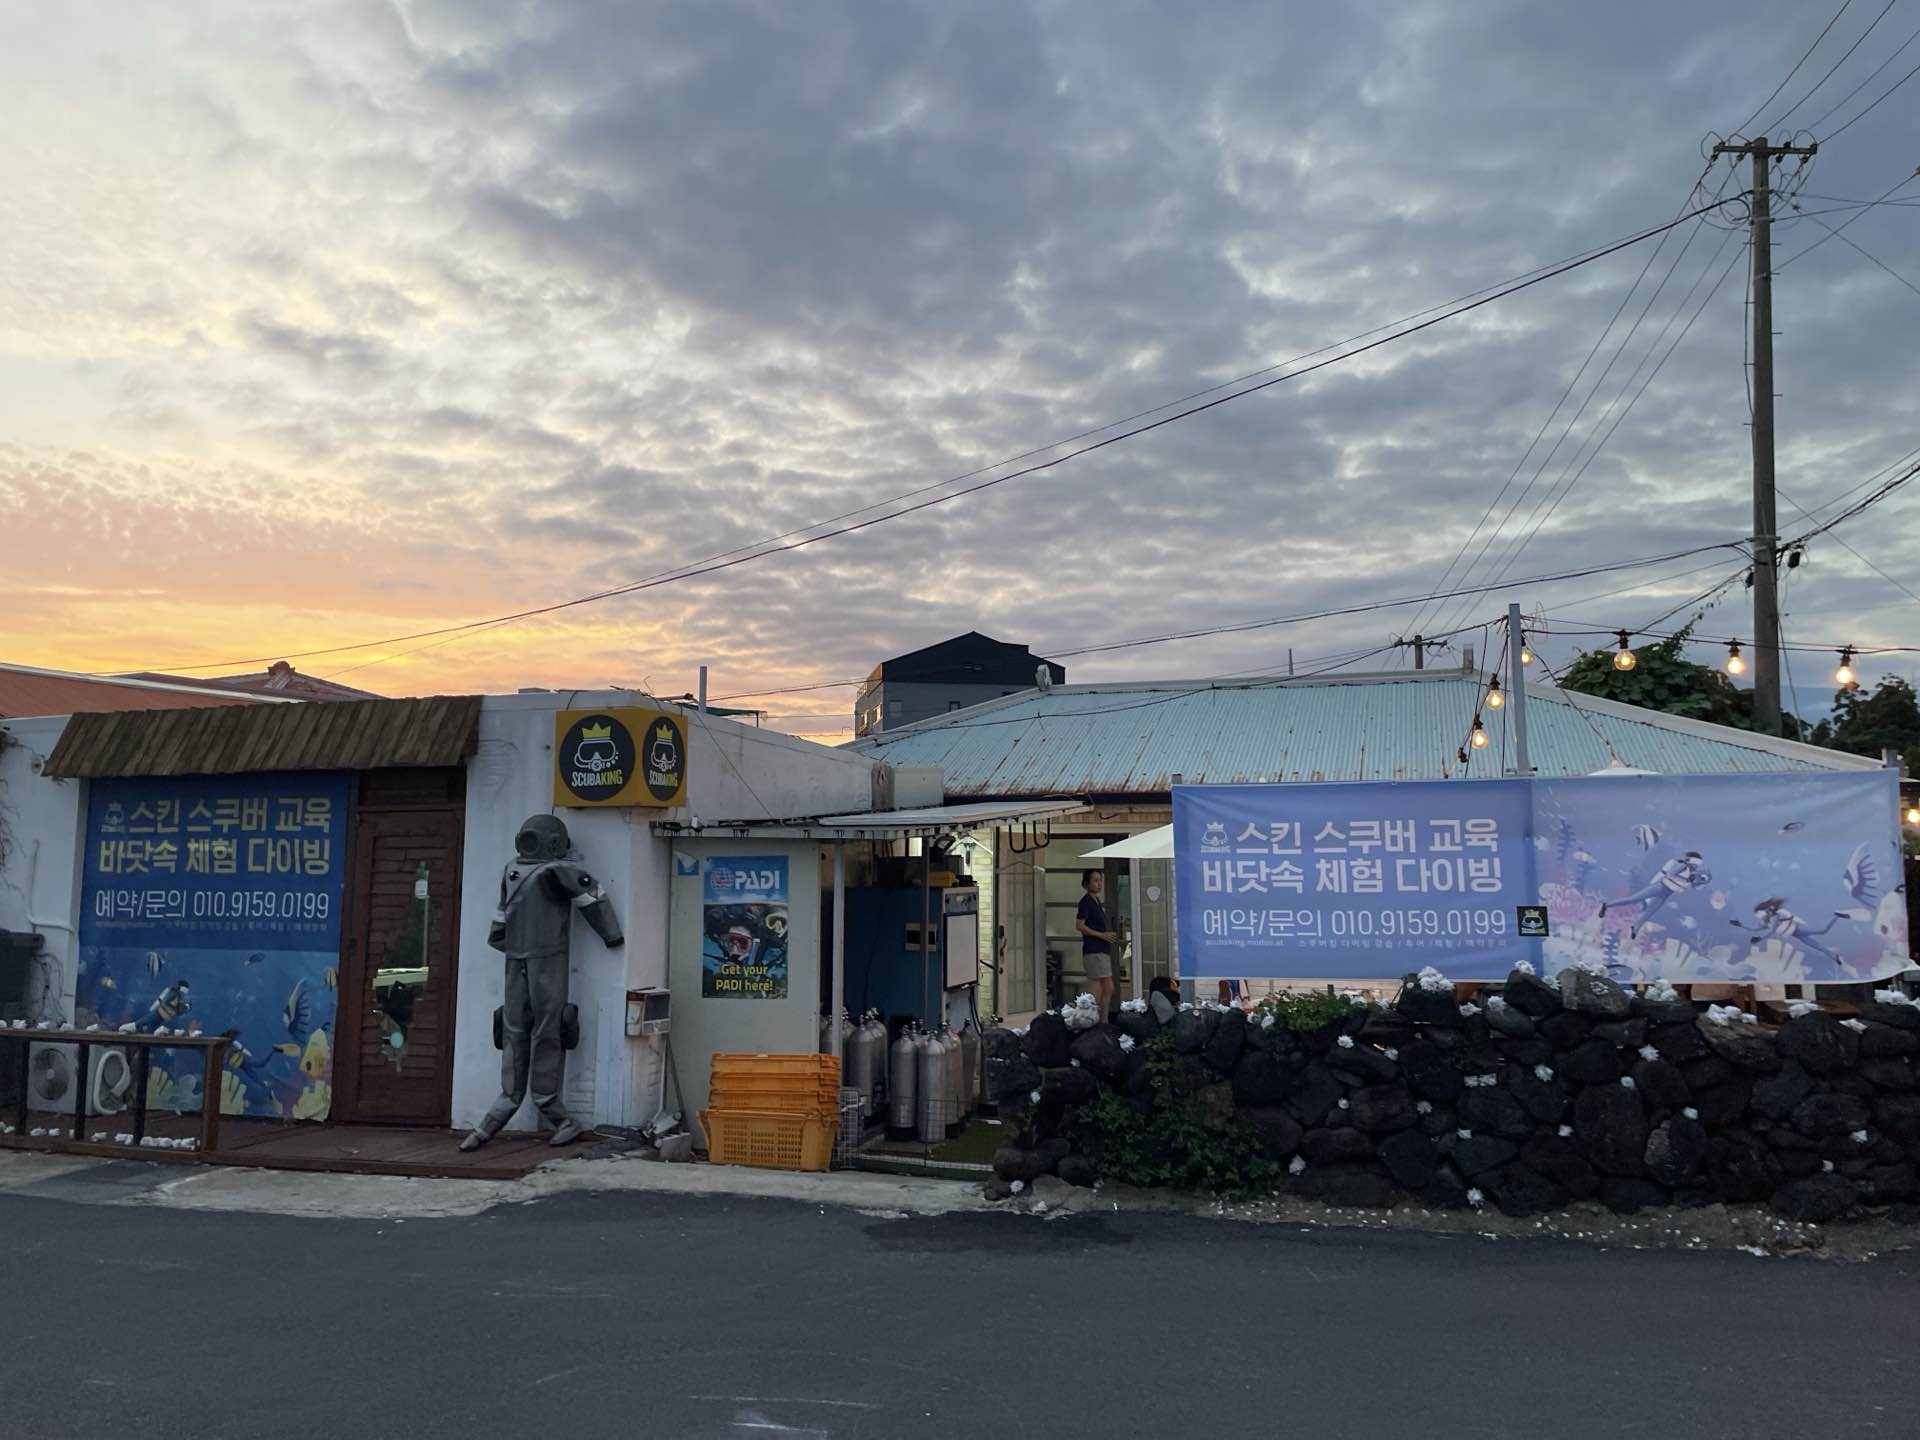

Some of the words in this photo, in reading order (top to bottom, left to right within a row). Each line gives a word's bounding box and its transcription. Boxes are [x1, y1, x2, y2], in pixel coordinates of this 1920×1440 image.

[571, 769, 623, 787] SCUBAKING
[649, 770, 678, 787] SCUBAKING
[129, 800, 180, 833] 스킨
[187, 798, 267, 833] 스쿠버
[275, 798, 332, 833] 교육
[1236, 822, 1302, 854] 스킨
[1314, 819, 1416, 854] 스쿠버
[1428, 818, 1498, 852] 교육
[98, 839, 178, 873] 바닷속
[186, 838, 237, 874] 체험
[247, 838, 330, 875] 다이빙
[735, 870, 781, 890] PADI
[1203, 858, 1304, 894] 바닷속
[1315, 857, 1383, 893] 체험
[1397, 857, 1502, 893] 다이빙
[96, 889, 187, 918] 예약/문의
[194, 890, 329, 919] 010.9159.0199
[1203, 908, 1322, 937] 예약/문의
[1331, 909, 1506, 936] 010.9159.0199
[716, 979, 742, 991] PADI
[744, 978, 773, 991] here!
[721, 964, 740, 975] Get
[742, 965, 768, 977] your
